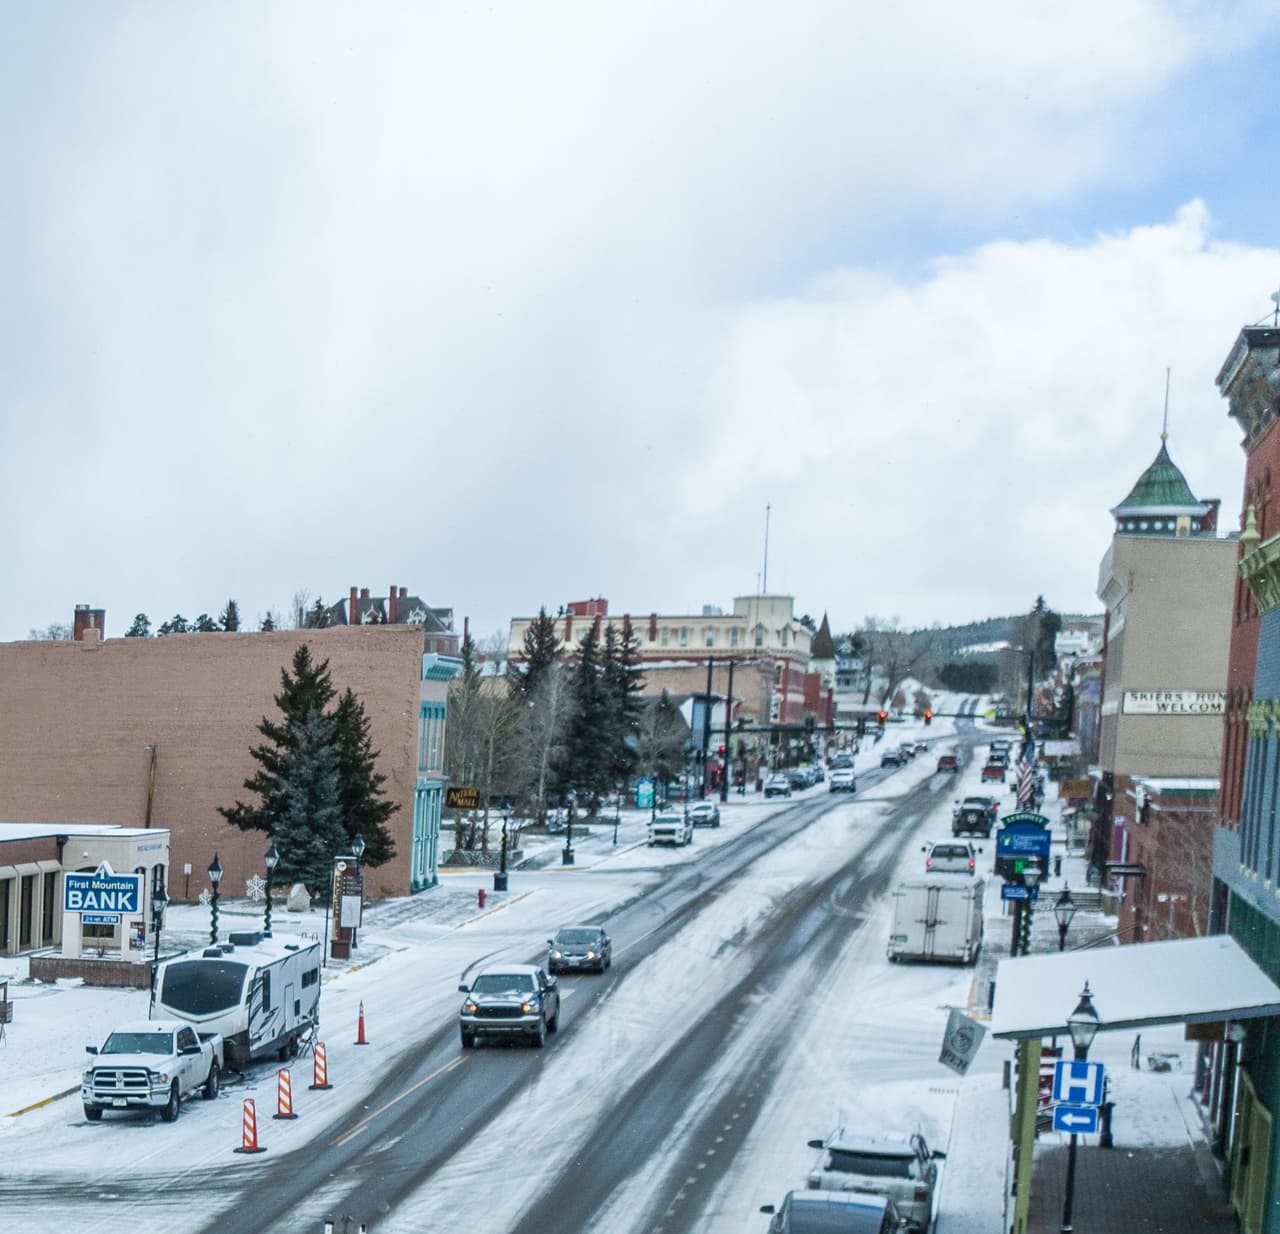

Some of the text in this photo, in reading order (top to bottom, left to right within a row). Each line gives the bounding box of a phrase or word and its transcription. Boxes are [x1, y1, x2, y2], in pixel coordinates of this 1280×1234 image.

[1130, 692, 1183, 701] SKIERS
[1156, 703, 1222, 713] WELCOM
[69, 880, 134, 890] First Mountain
[68, 890, 133, 910] BANK
[1060, 1063, 1097, 1102] H
